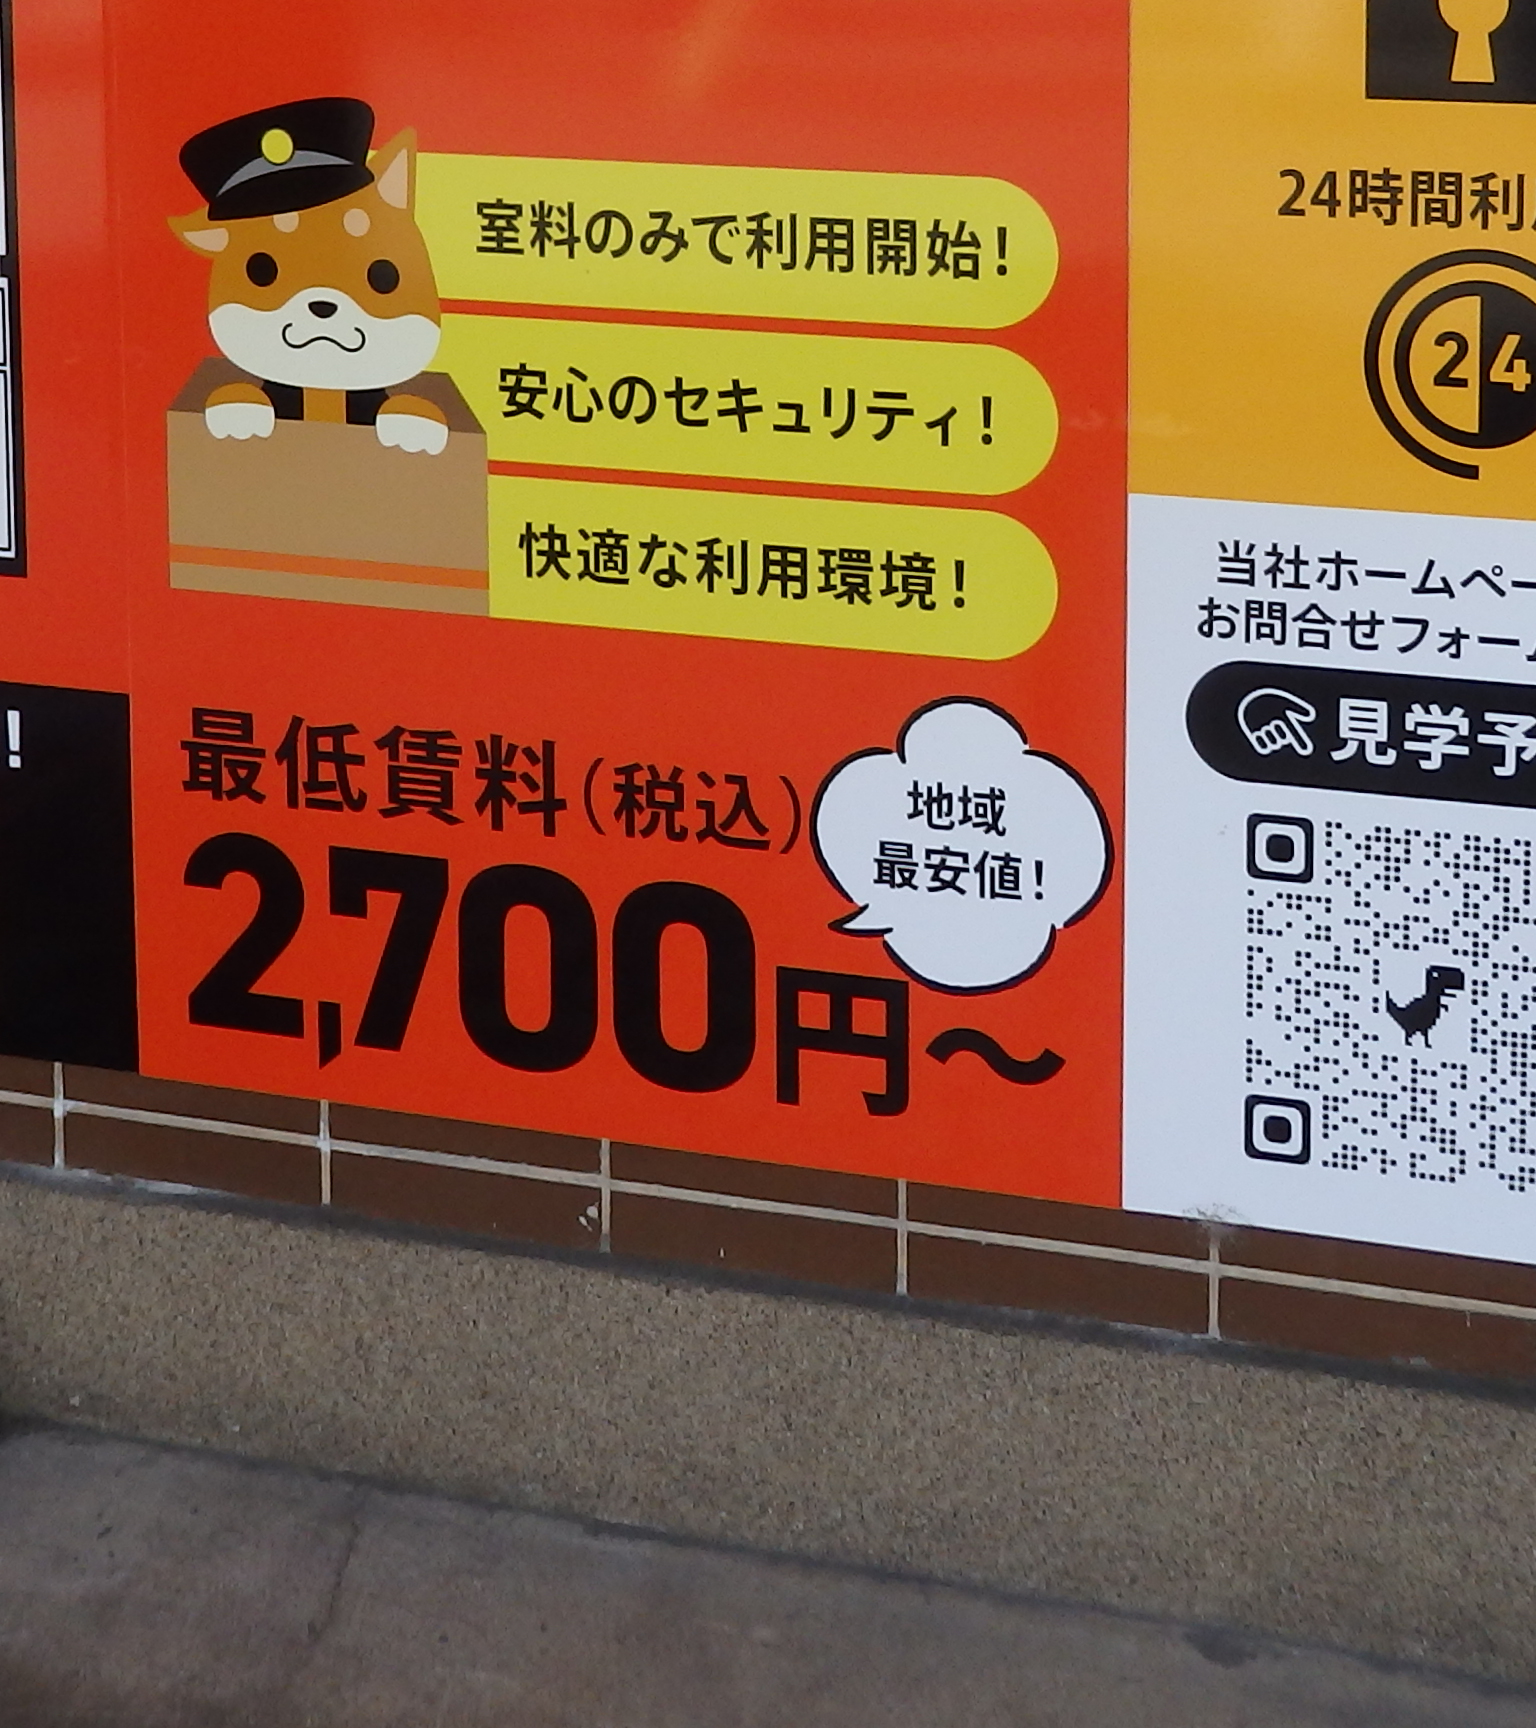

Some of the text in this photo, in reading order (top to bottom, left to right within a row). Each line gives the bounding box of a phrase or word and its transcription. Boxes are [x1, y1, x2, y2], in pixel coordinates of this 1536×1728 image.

[477, 198, 1007, 280] 室料のみで利用開始!
[1427, 325, 1536, 401] 24
[499, 363, 992, 446] 安心のセキュリティ!
[519, 522, 964, 610] 快適な利用環境!
[181, 708, 801, 859] 最低賃料(税込)
[907, 780, 1006, 836] 地域
[874, 841, 1043, 900] 最安値!
